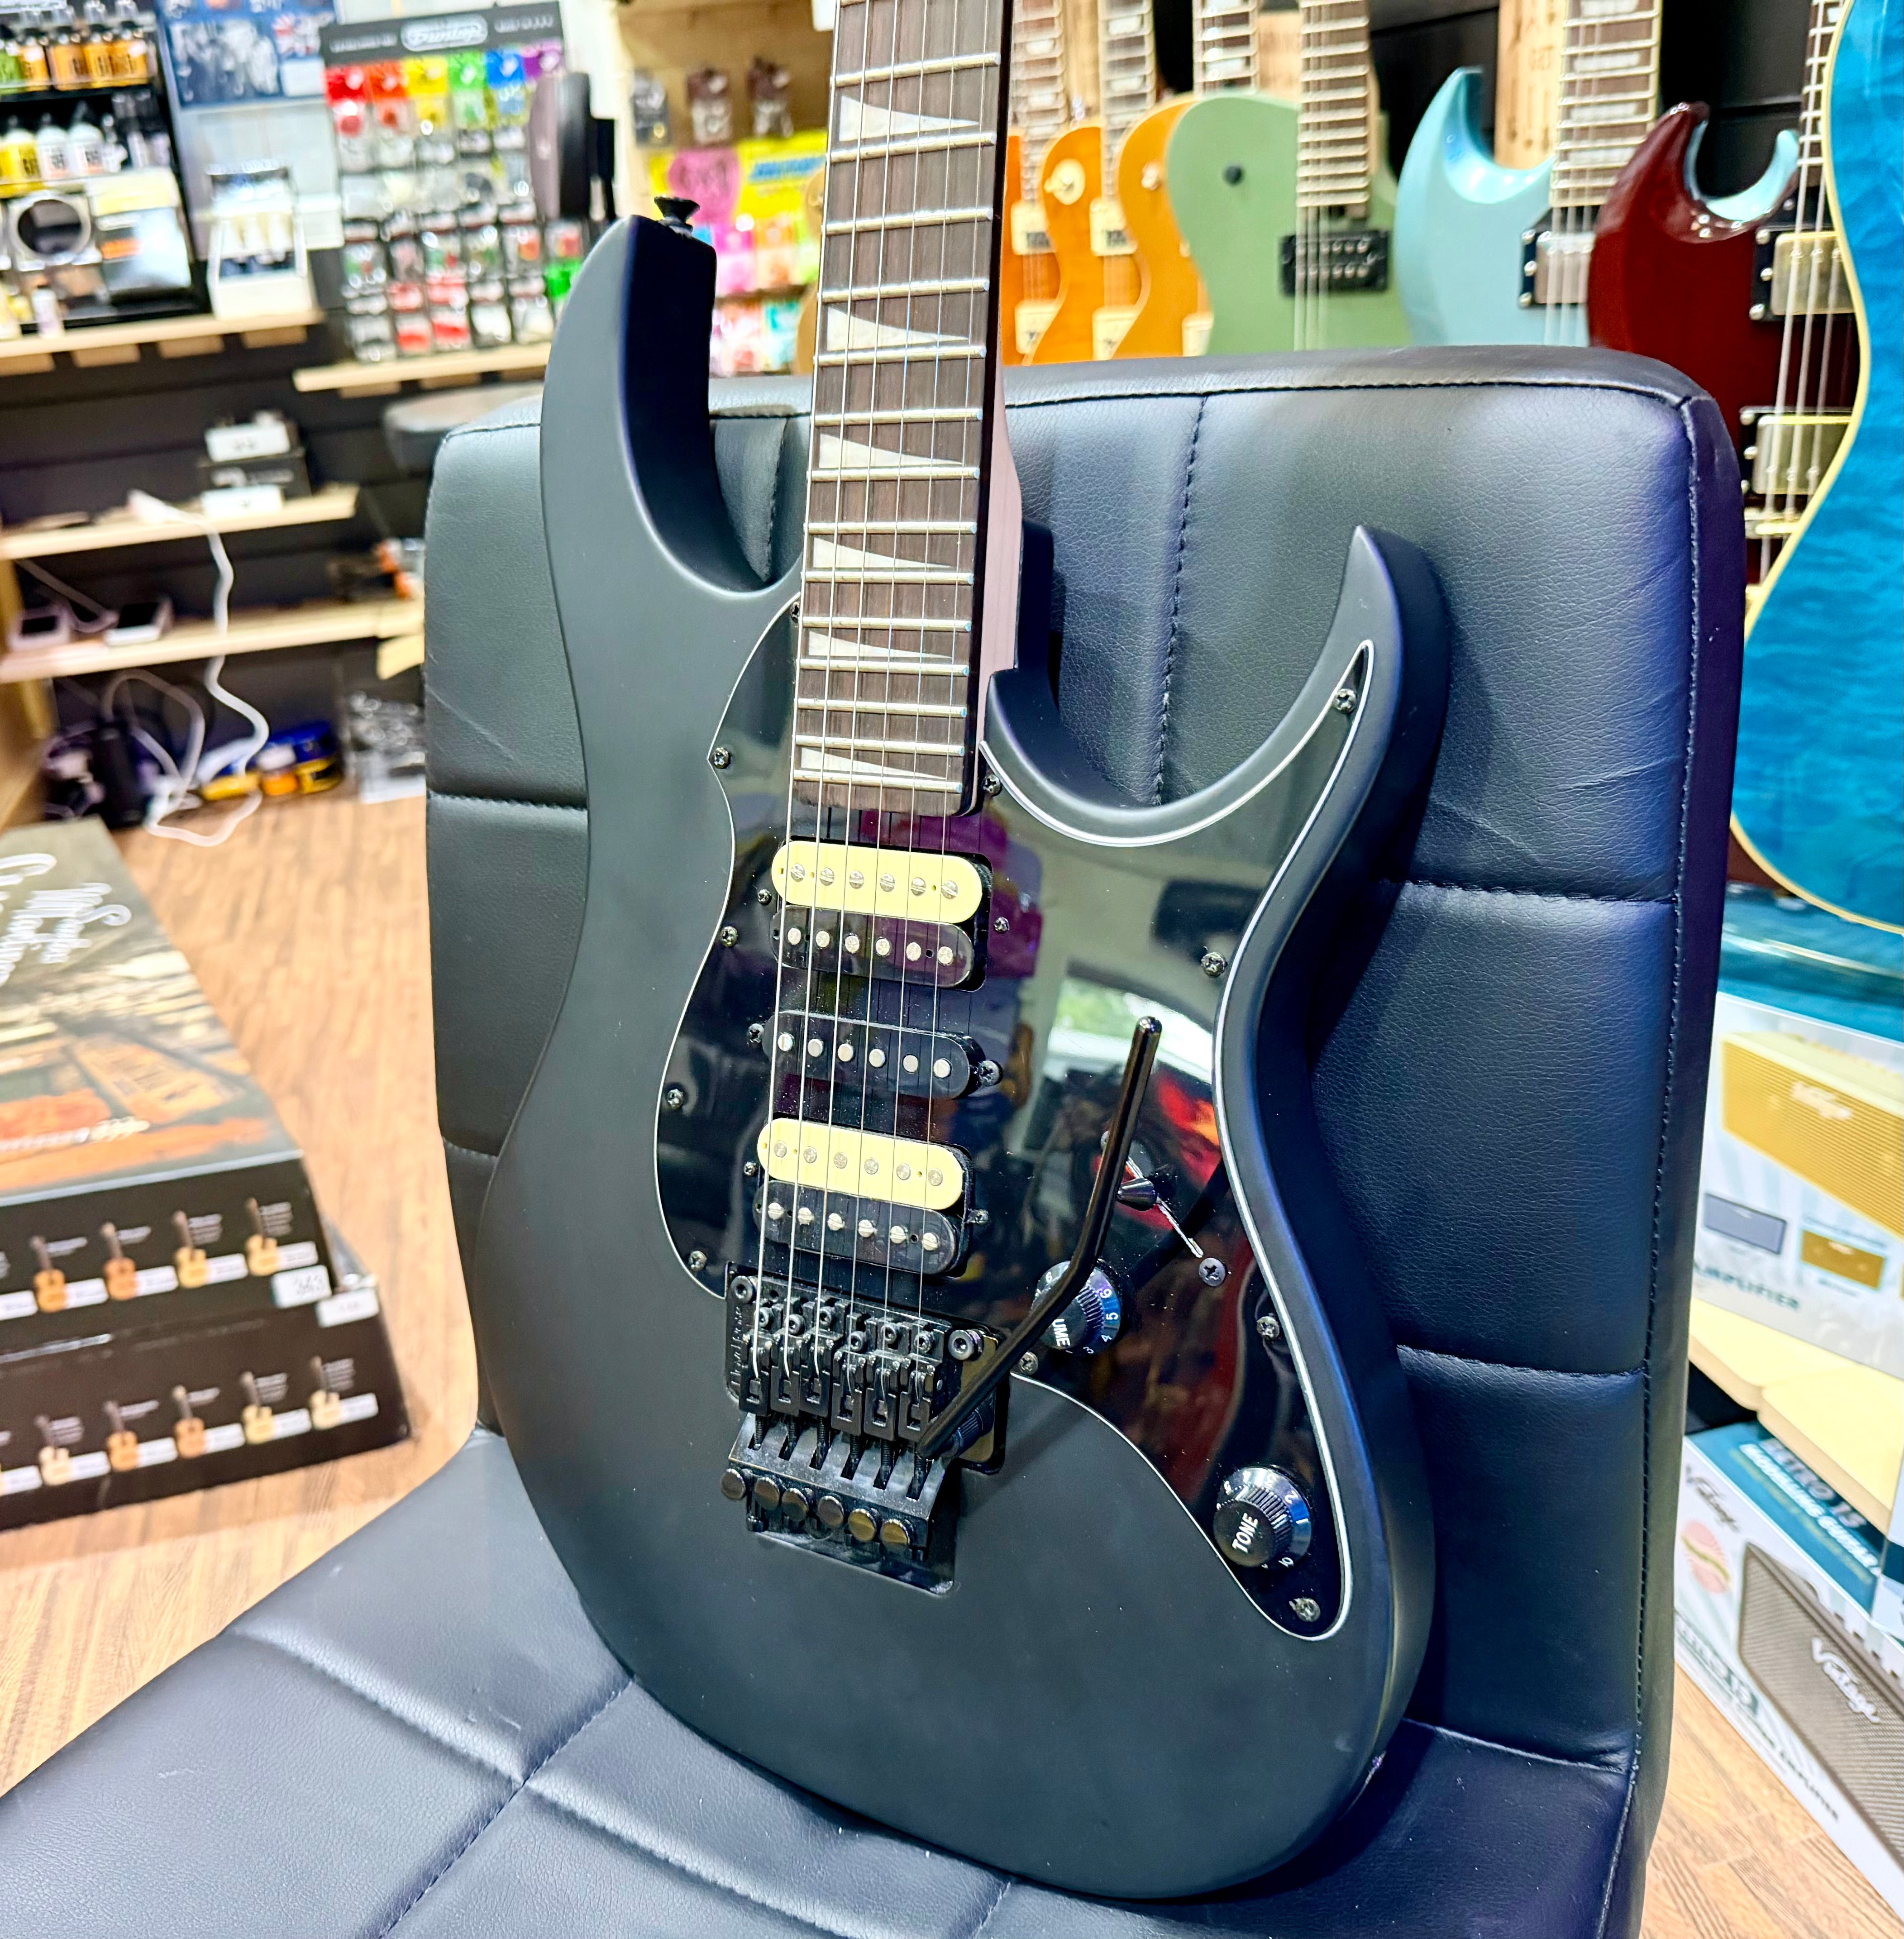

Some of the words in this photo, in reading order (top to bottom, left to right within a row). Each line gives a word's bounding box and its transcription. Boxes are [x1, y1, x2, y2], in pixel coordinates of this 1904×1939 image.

[1106, 1312, 1118, 1320] 5
[1052, 1318, 1071, 1347] UME
[1101, 1334, 1112, 1342] 4
[1083, 1346, 1094, 1354] 3
[1285, 1490, 1298, 1504] 2
[1232, 1513, 1259, 1553] TONE
[1817, 1515, 1878, 1568] GUITAR
[1279, 1557, 1294, 1568] 10
[1811, 1637, 1881, 1723] Vintage
